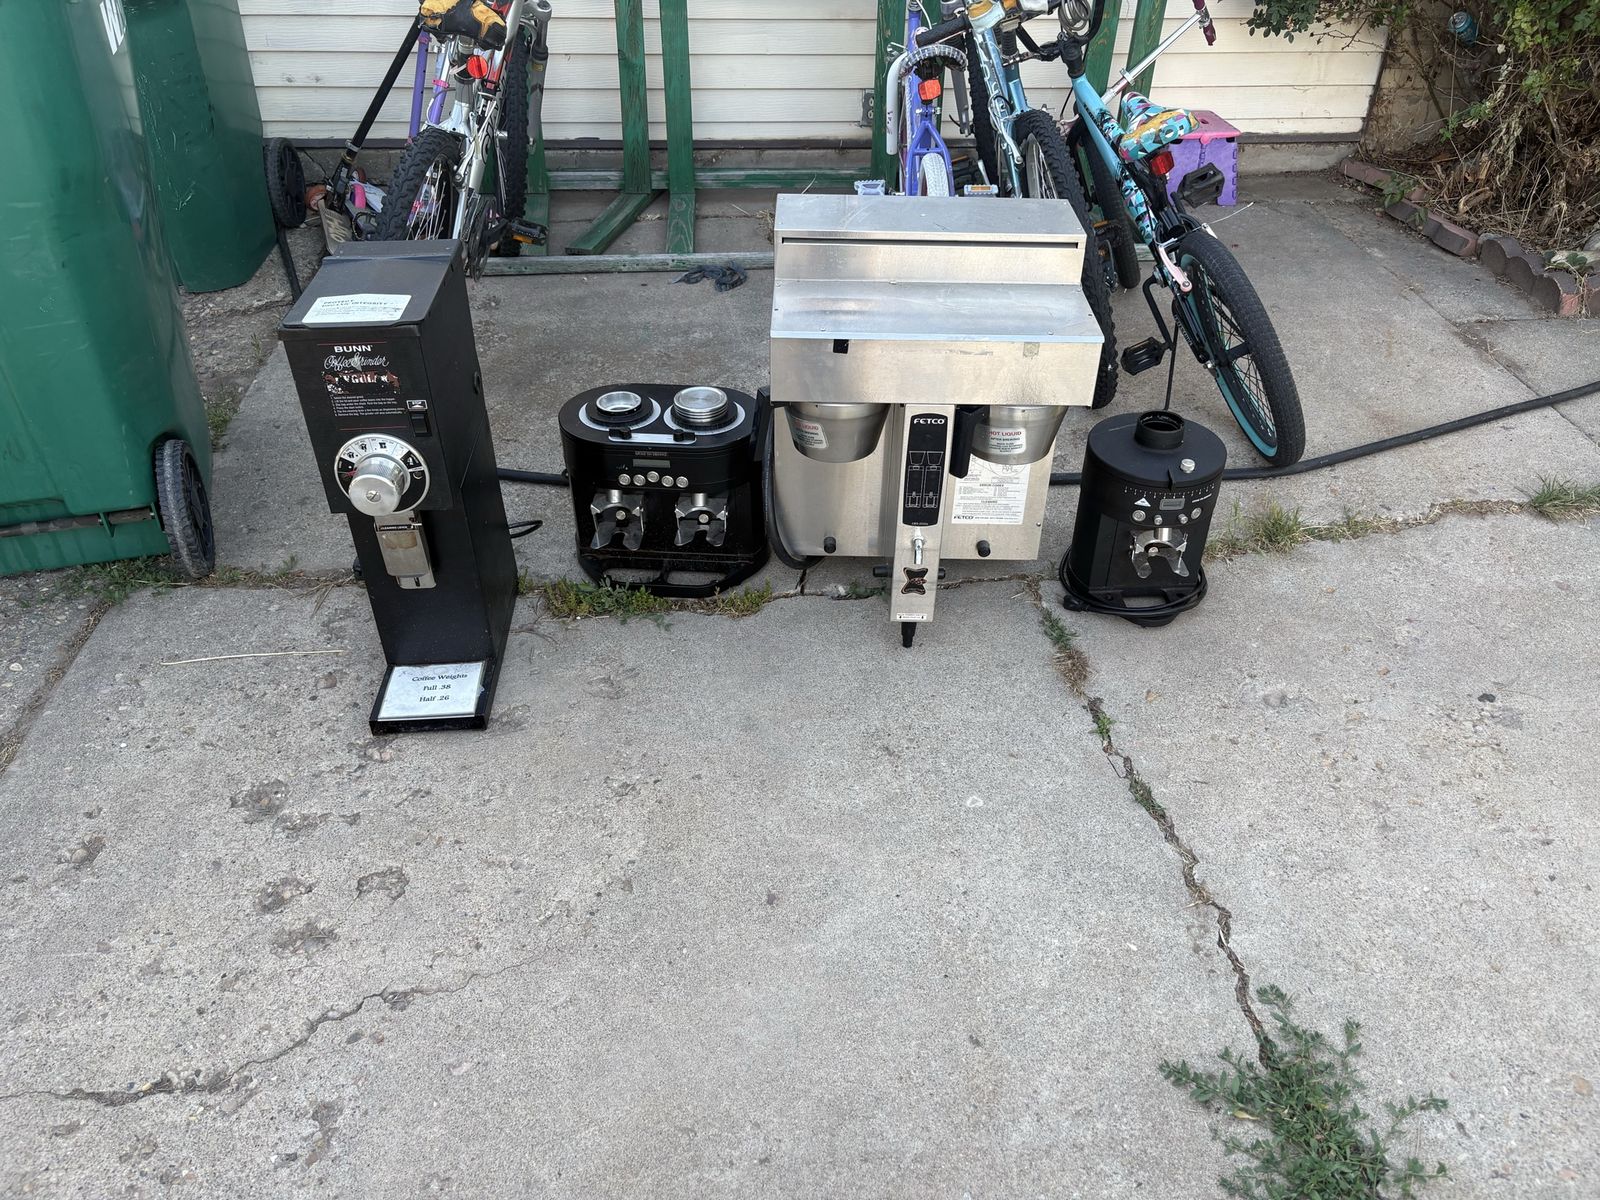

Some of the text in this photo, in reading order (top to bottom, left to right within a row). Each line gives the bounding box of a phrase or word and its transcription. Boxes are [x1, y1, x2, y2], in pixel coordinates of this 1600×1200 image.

[333, 345, 372, 353] BUNN
[324, 354, 352, 371] Coffee
[913, 417, 945, 425] FETCO
